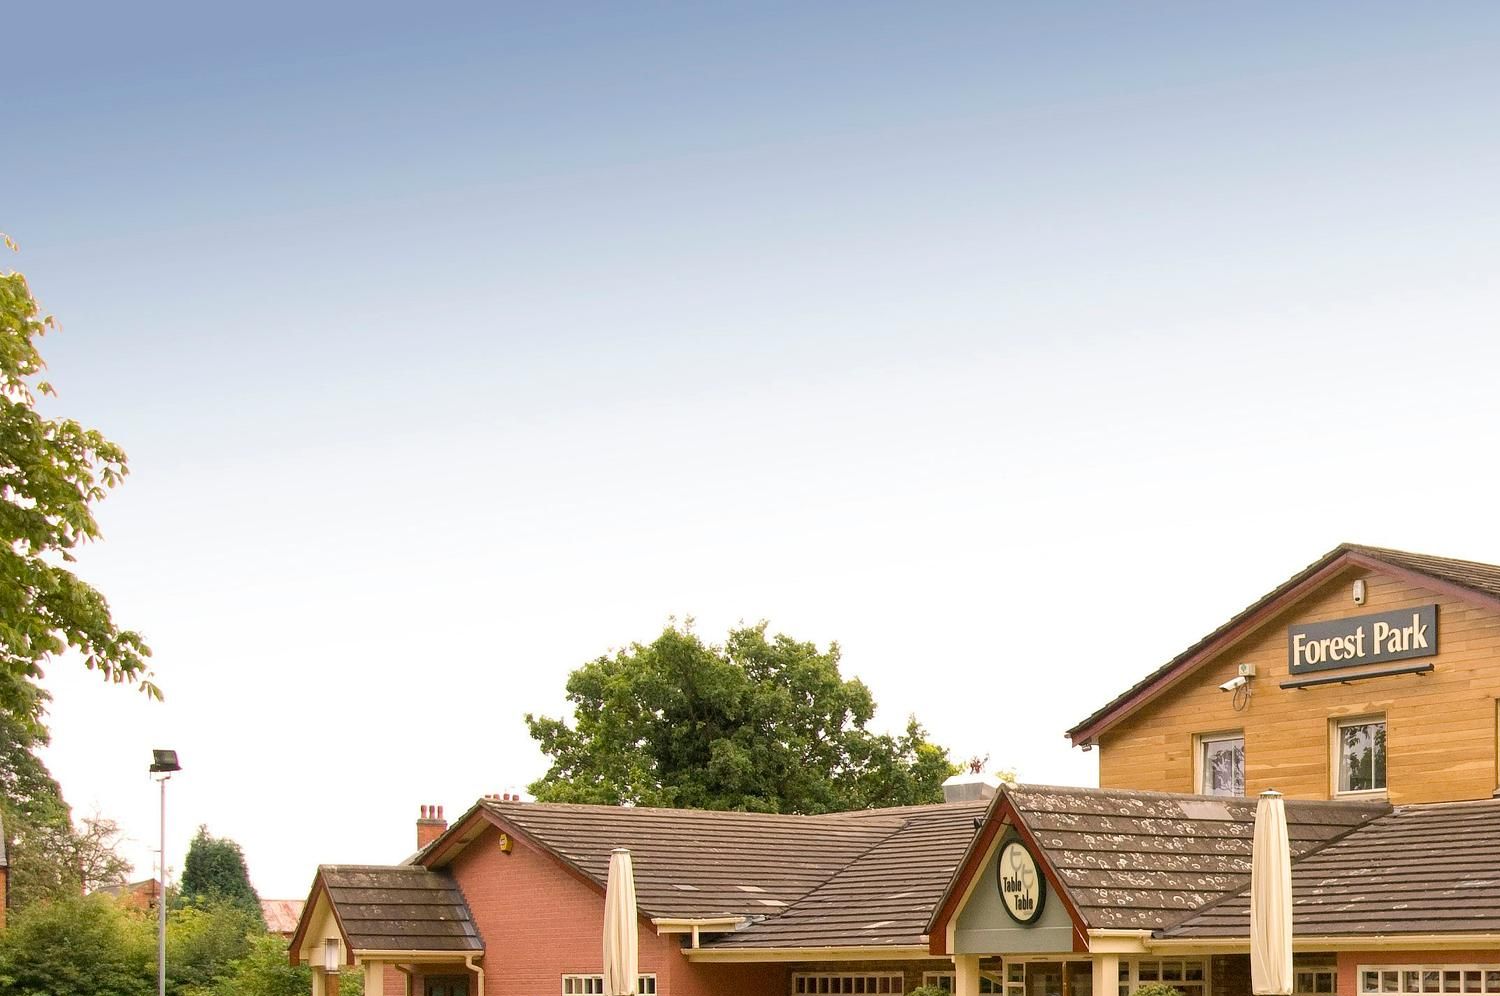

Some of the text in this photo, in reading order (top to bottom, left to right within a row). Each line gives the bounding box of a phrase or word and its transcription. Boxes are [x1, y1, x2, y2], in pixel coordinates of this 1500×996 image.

[1293, 613, 1429, 666] Forest Park
[1003, 872, 1022, 893] Table
[1014, 889, 1034, 911] Table
